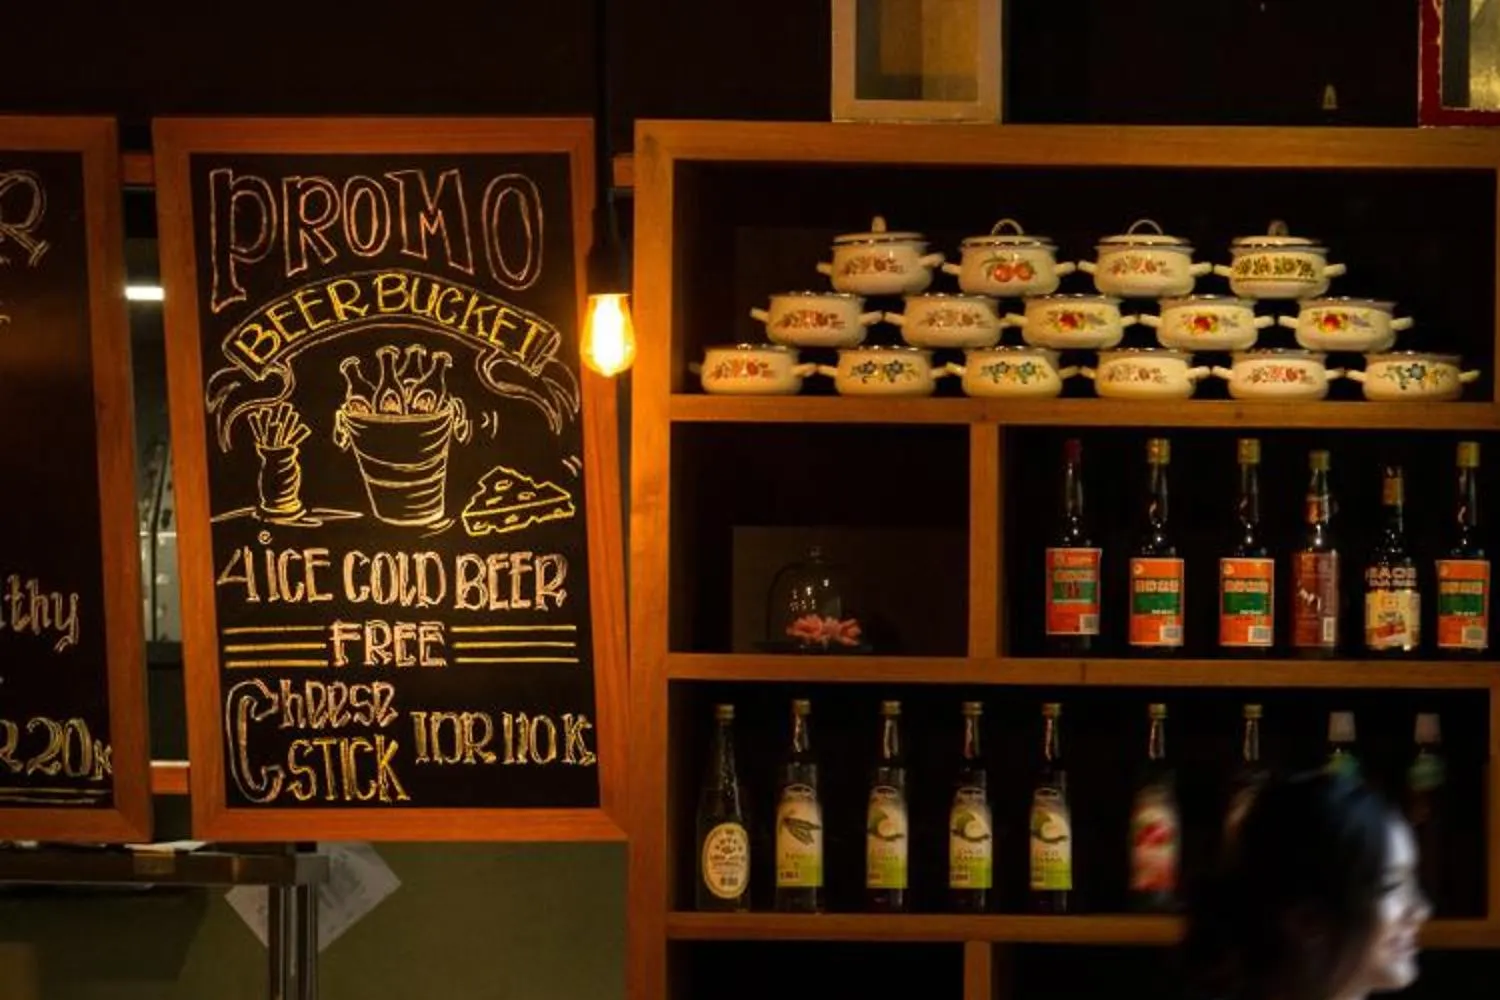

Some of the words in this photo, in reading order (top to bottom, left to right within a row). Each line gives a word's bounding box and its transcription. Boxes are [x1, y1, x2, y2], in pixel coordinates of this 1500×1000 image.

[209, 168, 543, 313] PROMO
[235, 279, 369, 366] BEER
[373, 273, 549, 361] BUCKET
[215, 545, 260, 603] 4
[343, 550, 447, 608] COLD
[453, 551, 569, 611] BEER
[0, 572, 80, 653] thy
[329, 619, 447, 667] FREE
[287, 734, 411, 802] STICK
[409, 711, 497, 765] IDR
